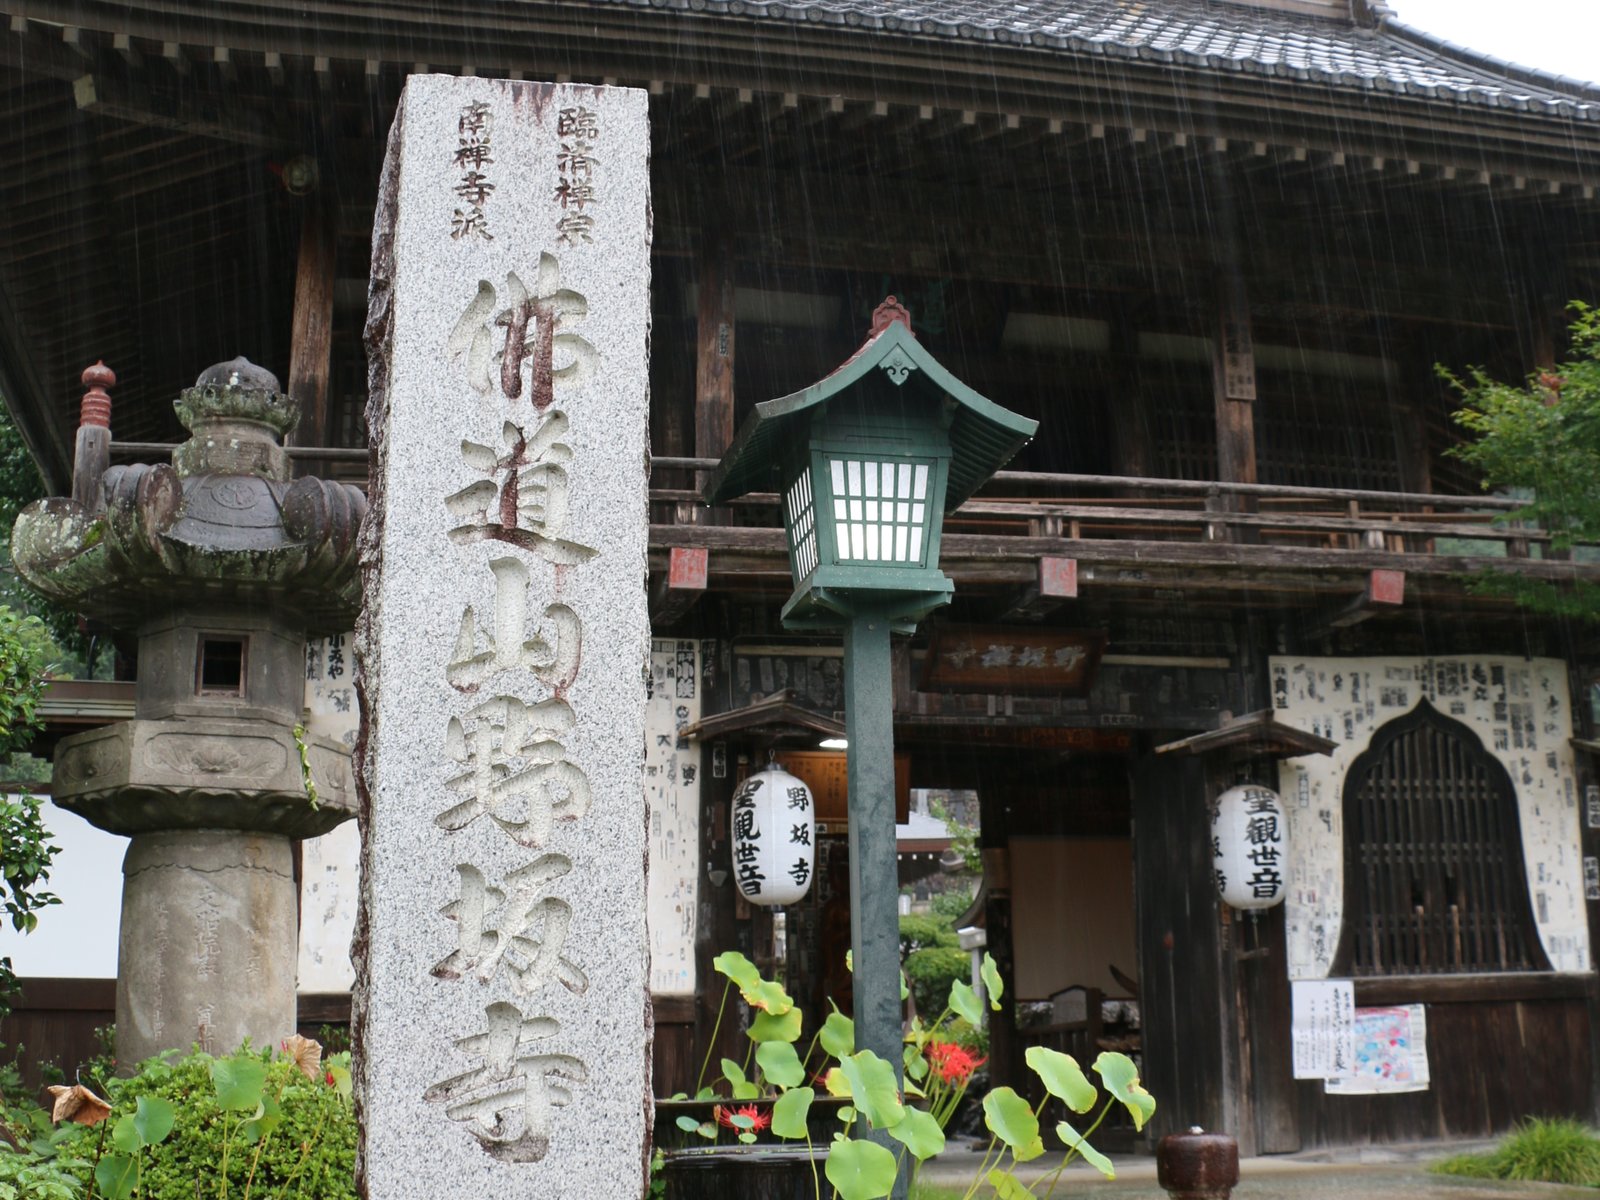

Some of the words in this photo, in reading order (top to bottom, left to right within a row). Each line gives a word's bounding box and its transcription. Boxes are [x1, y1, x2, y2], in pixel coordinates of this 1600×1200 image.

[450, 99, 496, 242] 南禅寺派
[733, 779, 766, 896] 聖観世音
[786, 786, 812, 886] 野坂寺
[1242, 788, 1282, 899] 聖観世音
